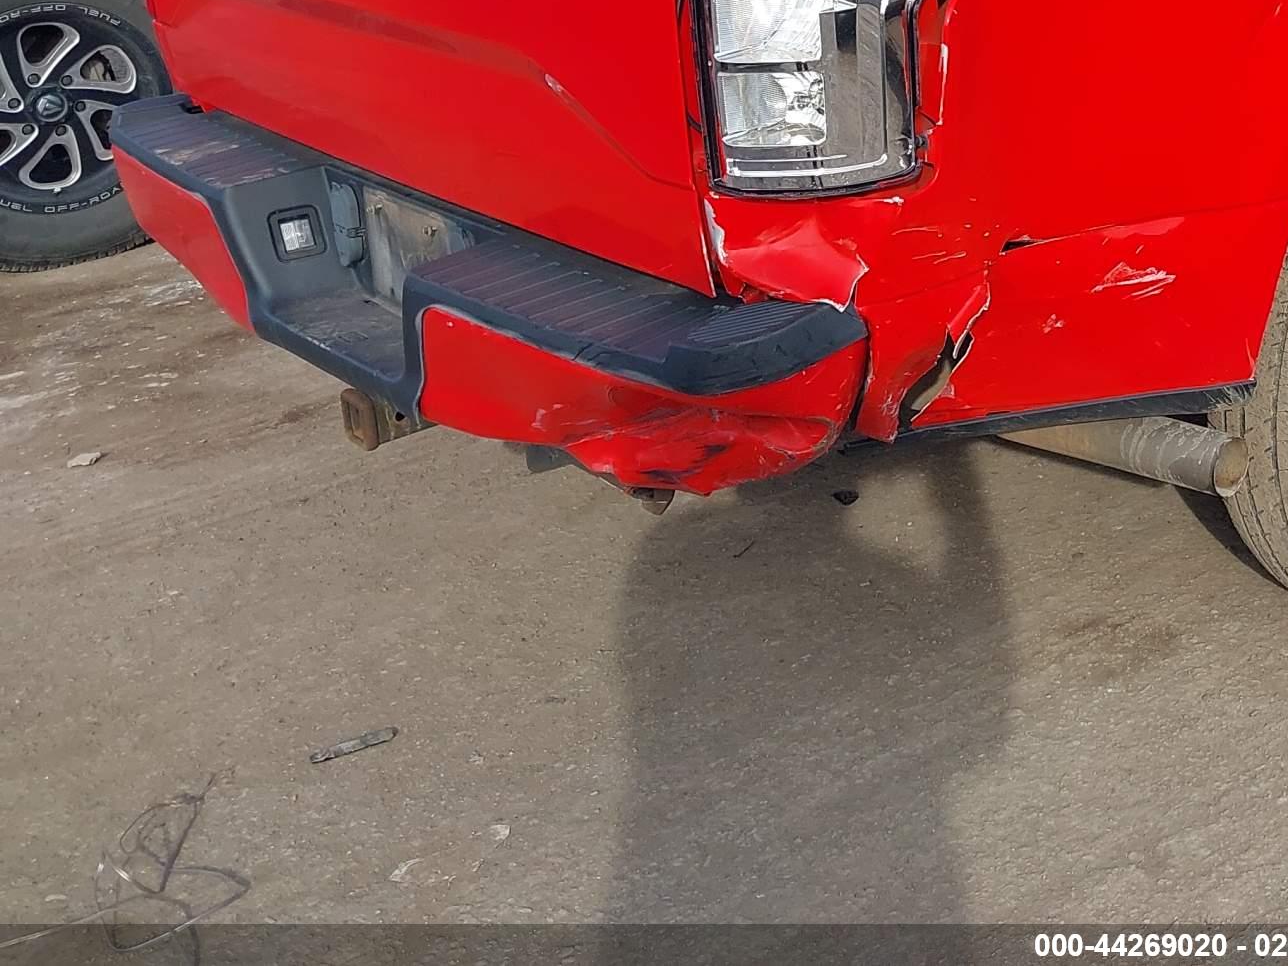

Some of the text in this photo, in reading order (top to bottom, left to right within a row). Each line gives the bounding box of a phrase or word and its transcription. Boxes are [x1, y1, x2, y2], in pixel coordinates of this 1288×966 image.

[0, 4, 121, 26] FUEL OFF-RO
[0, 181, 125, 213] UEL OFF-ROA
